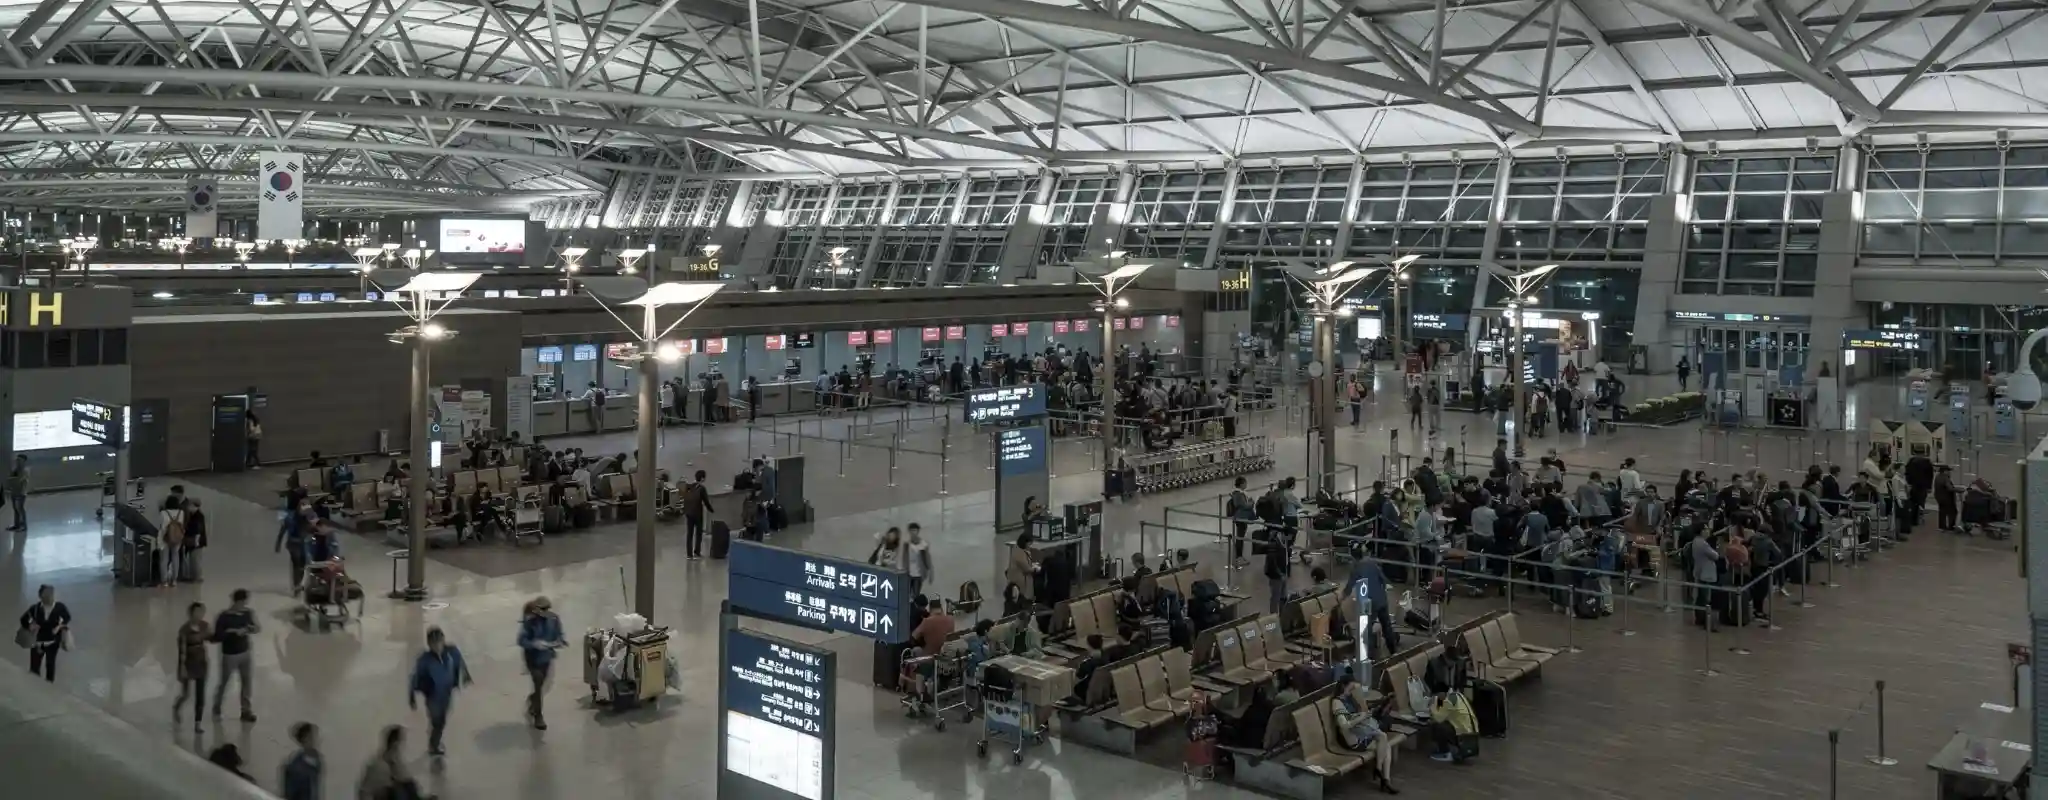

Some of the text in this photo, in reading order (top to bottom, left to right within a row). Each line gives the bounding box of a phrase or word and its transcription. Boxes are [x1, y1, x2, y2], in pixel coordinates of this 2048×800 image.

[709, 258, 718, 270] G
[1221, 271, 1248, 289] 19-36 H
[30, 292, 62, 326] H
[806, 575, 836, 590] Arrivals
[839, 573, 857, 589] 도착
[797, 605, 826, 624] Parking
[829, 605, 857, 624] 주차장
